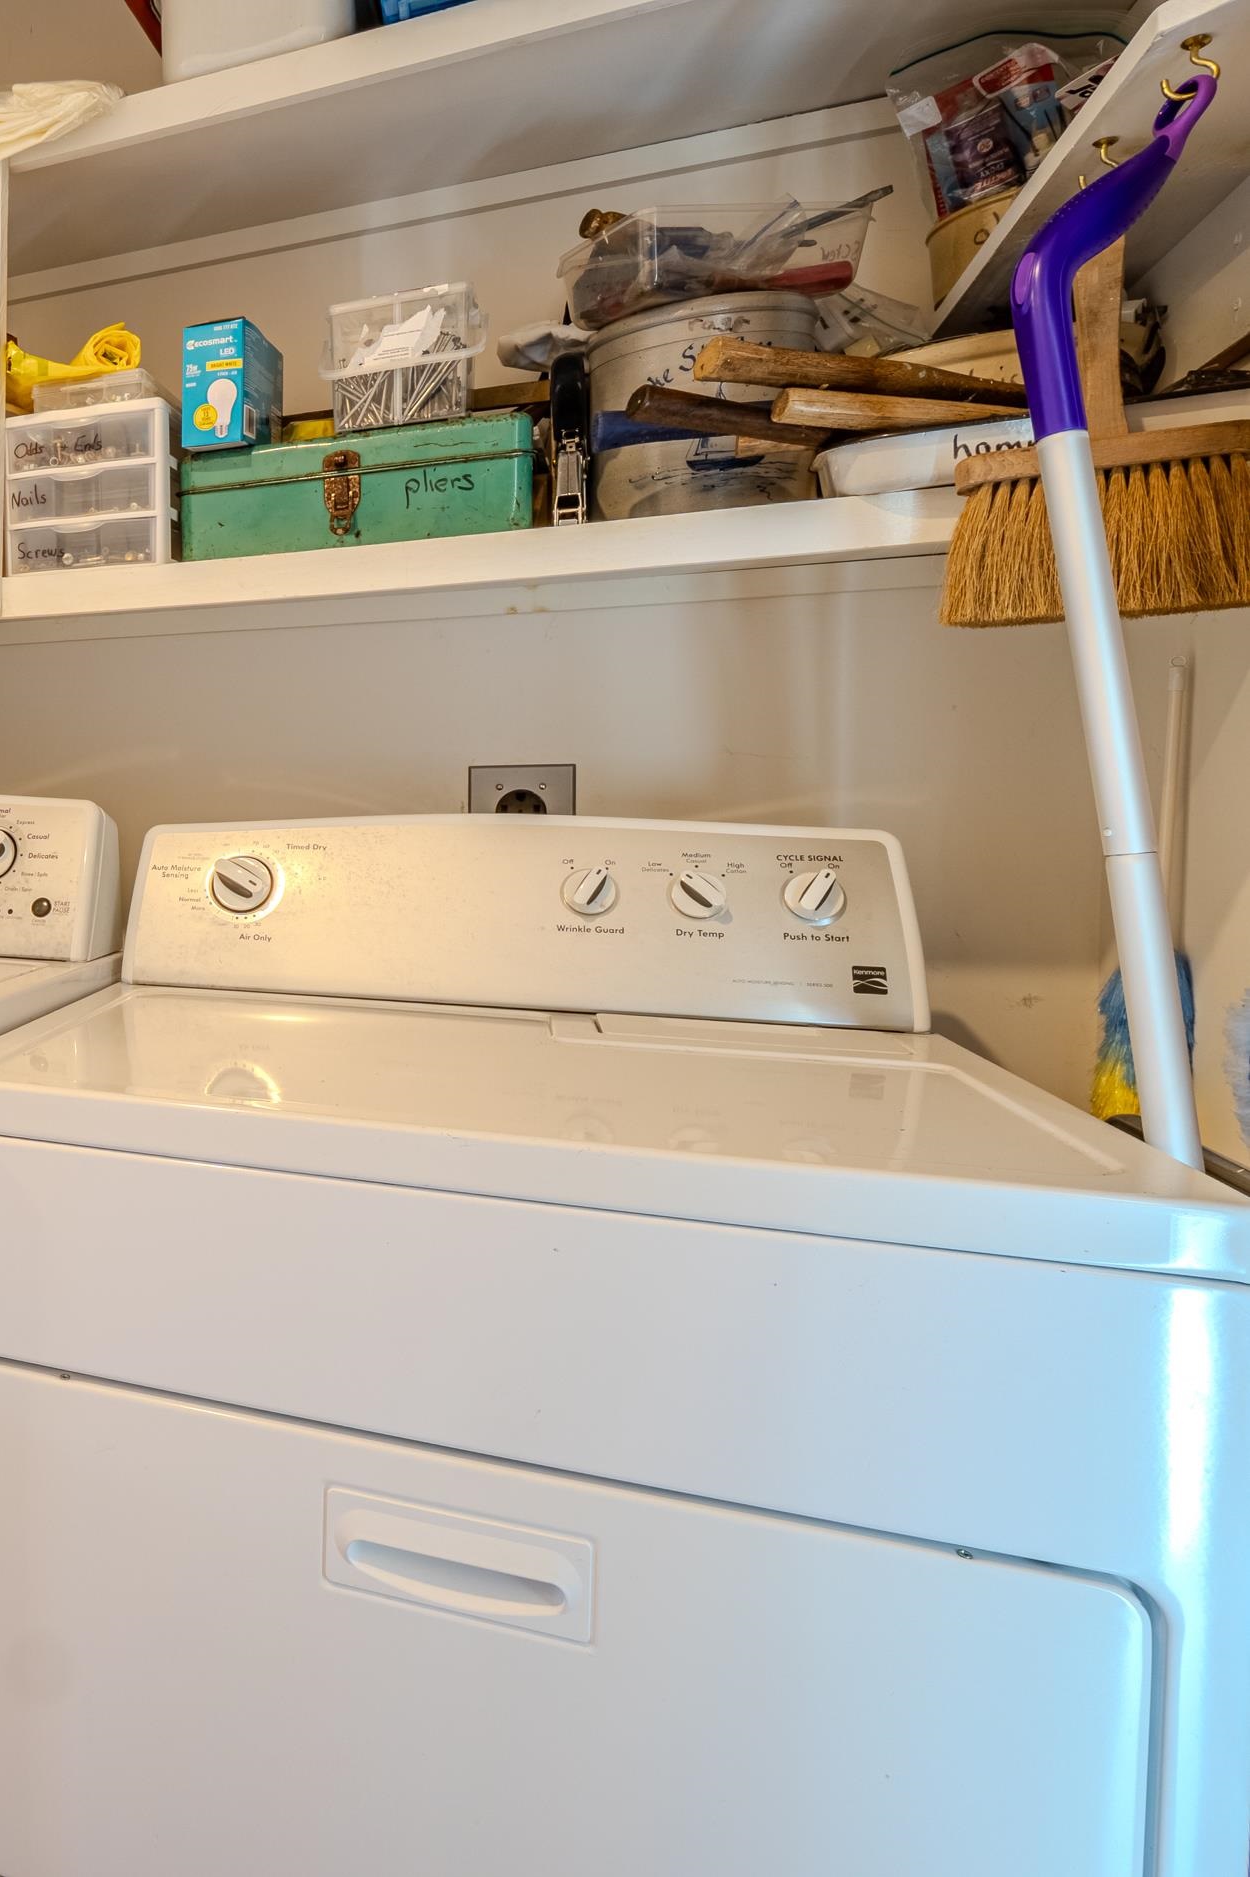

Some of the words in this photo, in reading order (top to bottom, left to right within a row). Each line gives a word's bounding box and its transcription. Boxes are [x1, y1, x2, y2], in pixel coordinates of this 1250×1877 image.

[194, 335, 234, 348] ecosmart
[219, 346, 235, 356] LED
[403, 467, 476, 509] pliers
[10, 484, 47, 508] Nails
[17, 542, 66, 560] Screws
[312, 843, 328, 851] Dry
[28, 852, 59, 860] Delicates
[776, 854, 805, 862] CYCLE
[161, 872, 189, 880] Sensing
[556, 924, 592, 934] Wrinkle
[594, 925, 625, 935] Guard
[675, 929, 694, 938] Dry
[697, 929, 725, 940] Temp
[253, 934, 272, 943] Only
[783, 932, 808, 942] Push
[810, 933, 821, 941] to
[824, 933, 850, 942] Start
[853, 968, 885, 977] Kenmore
